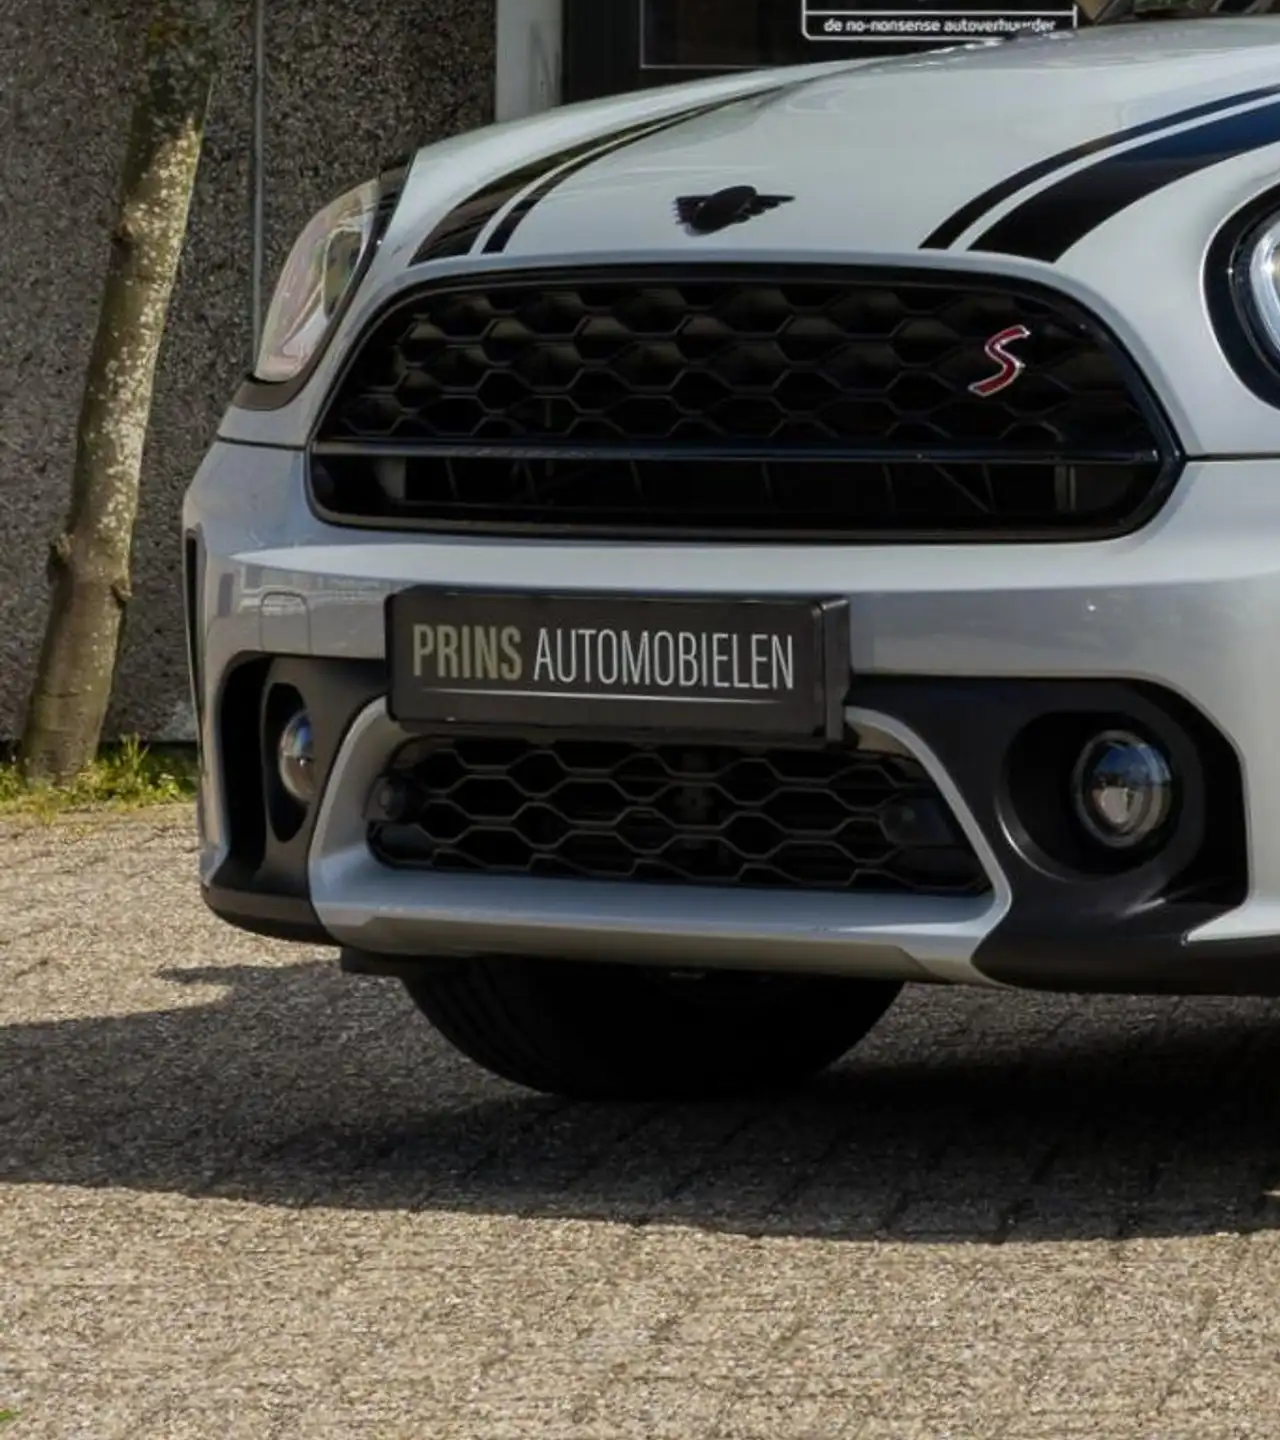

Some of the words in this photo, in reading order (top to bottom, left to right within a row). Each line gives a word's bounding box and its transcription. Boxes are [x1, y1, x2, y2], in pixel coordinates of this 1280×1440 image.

[824, 18, 842, 33] de
[846, 19, 941, 33] no-nonsense
[967, 324, 1031, 397] S
[412, 623, 524, 681] PRINS
[532, 627, 795, 691] AUTOMOBIELEN
